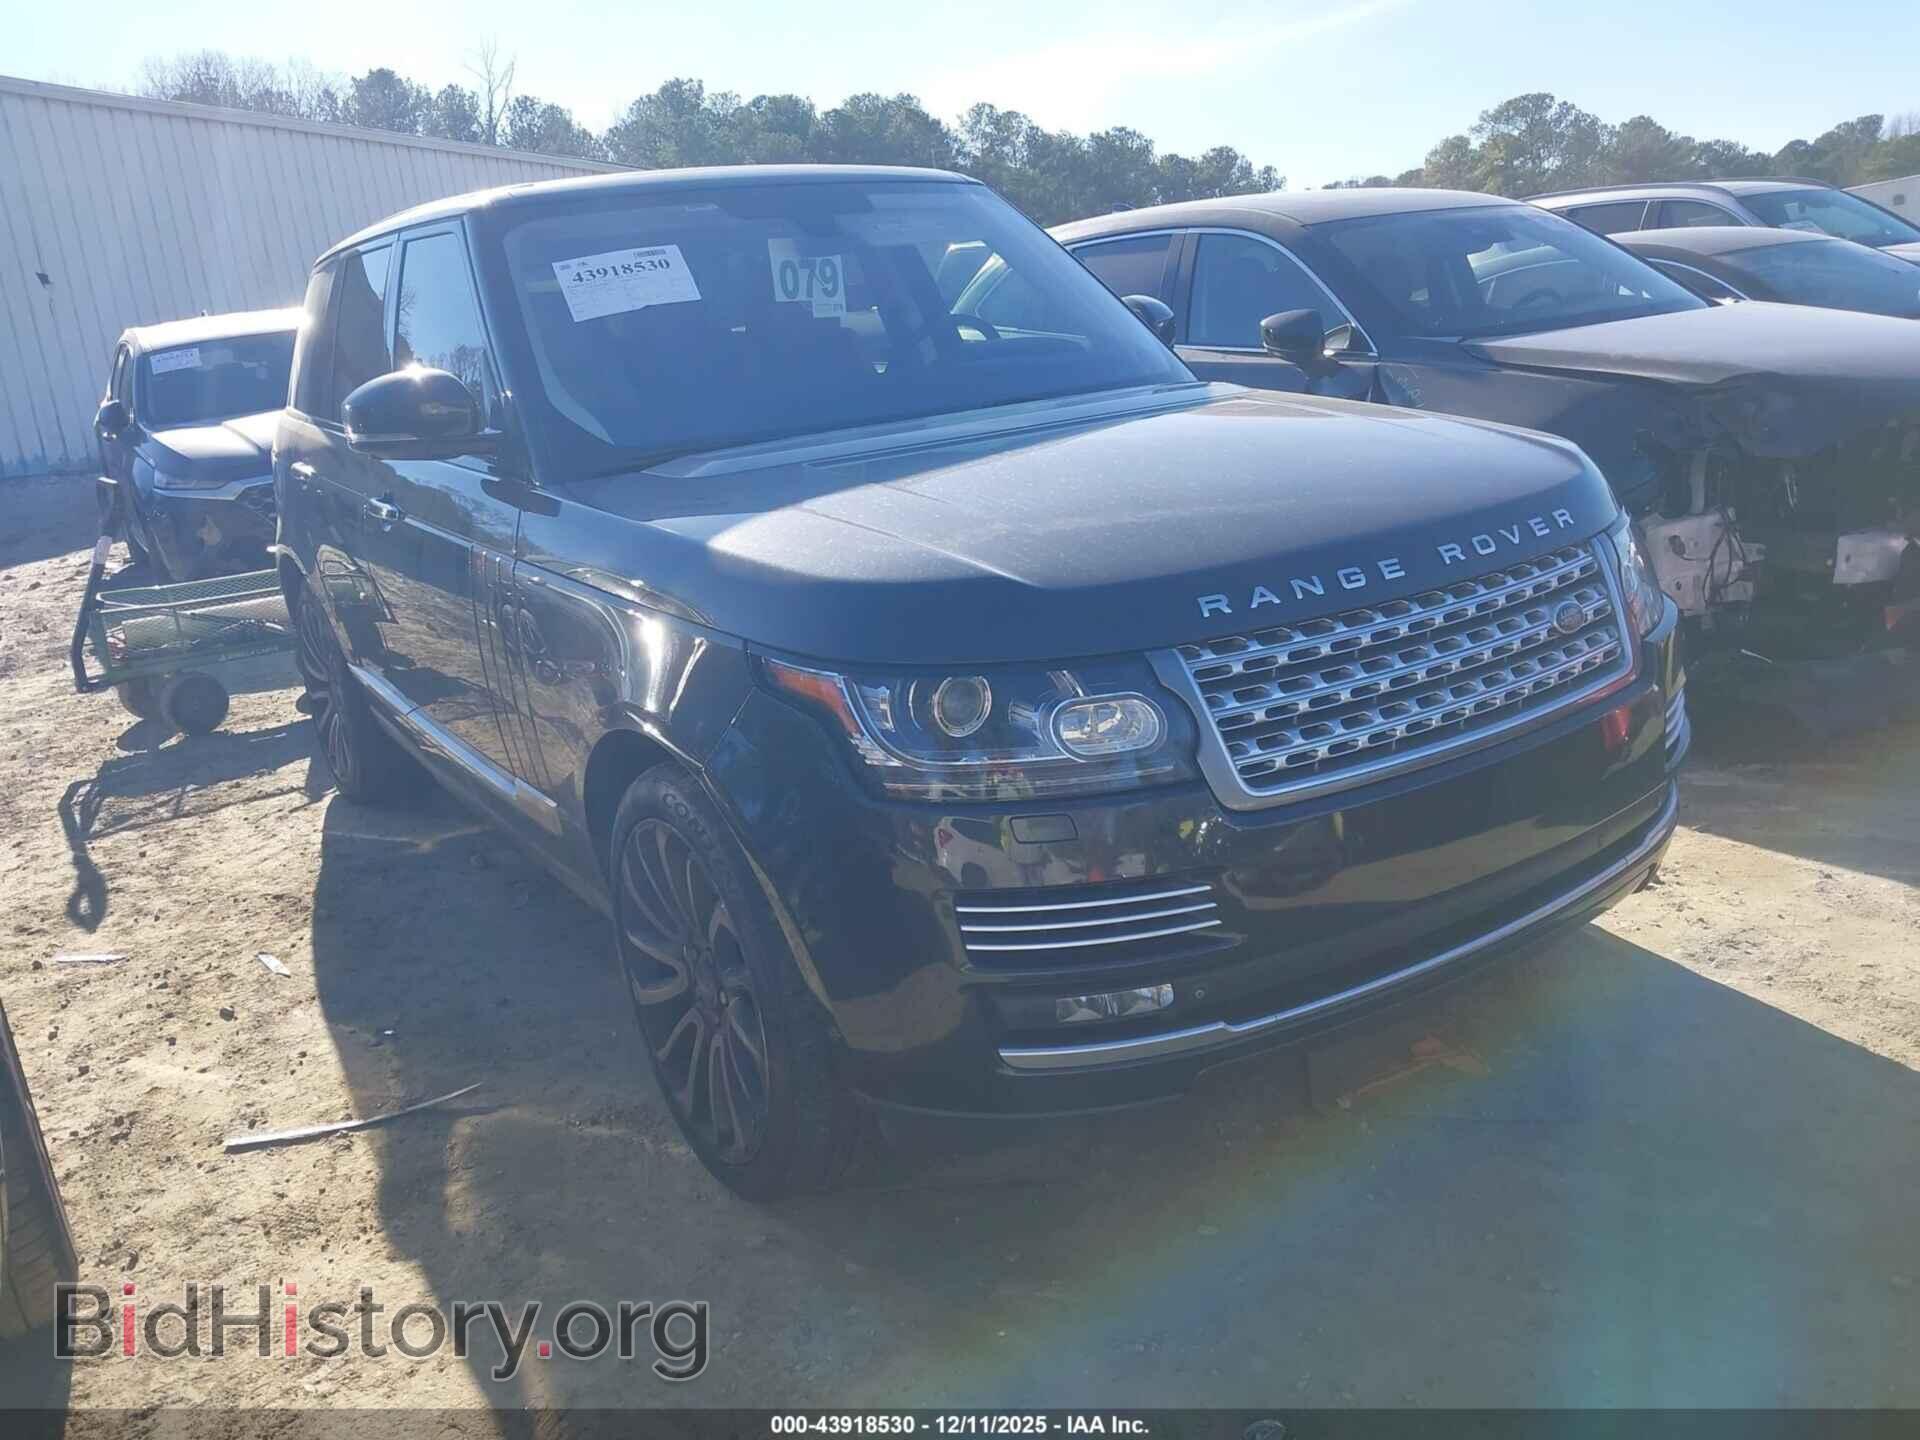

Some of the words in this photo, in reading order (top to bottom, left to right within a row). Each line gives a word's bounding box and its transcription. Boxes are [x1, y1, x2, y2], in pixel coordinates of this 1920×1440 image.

[572, 258, 671, 283] 43918530
[779, 258, 840, 299] 079
[1197, 557, 1407, 618] RANGE
[1436, 508, 1575, 566] ROVER
